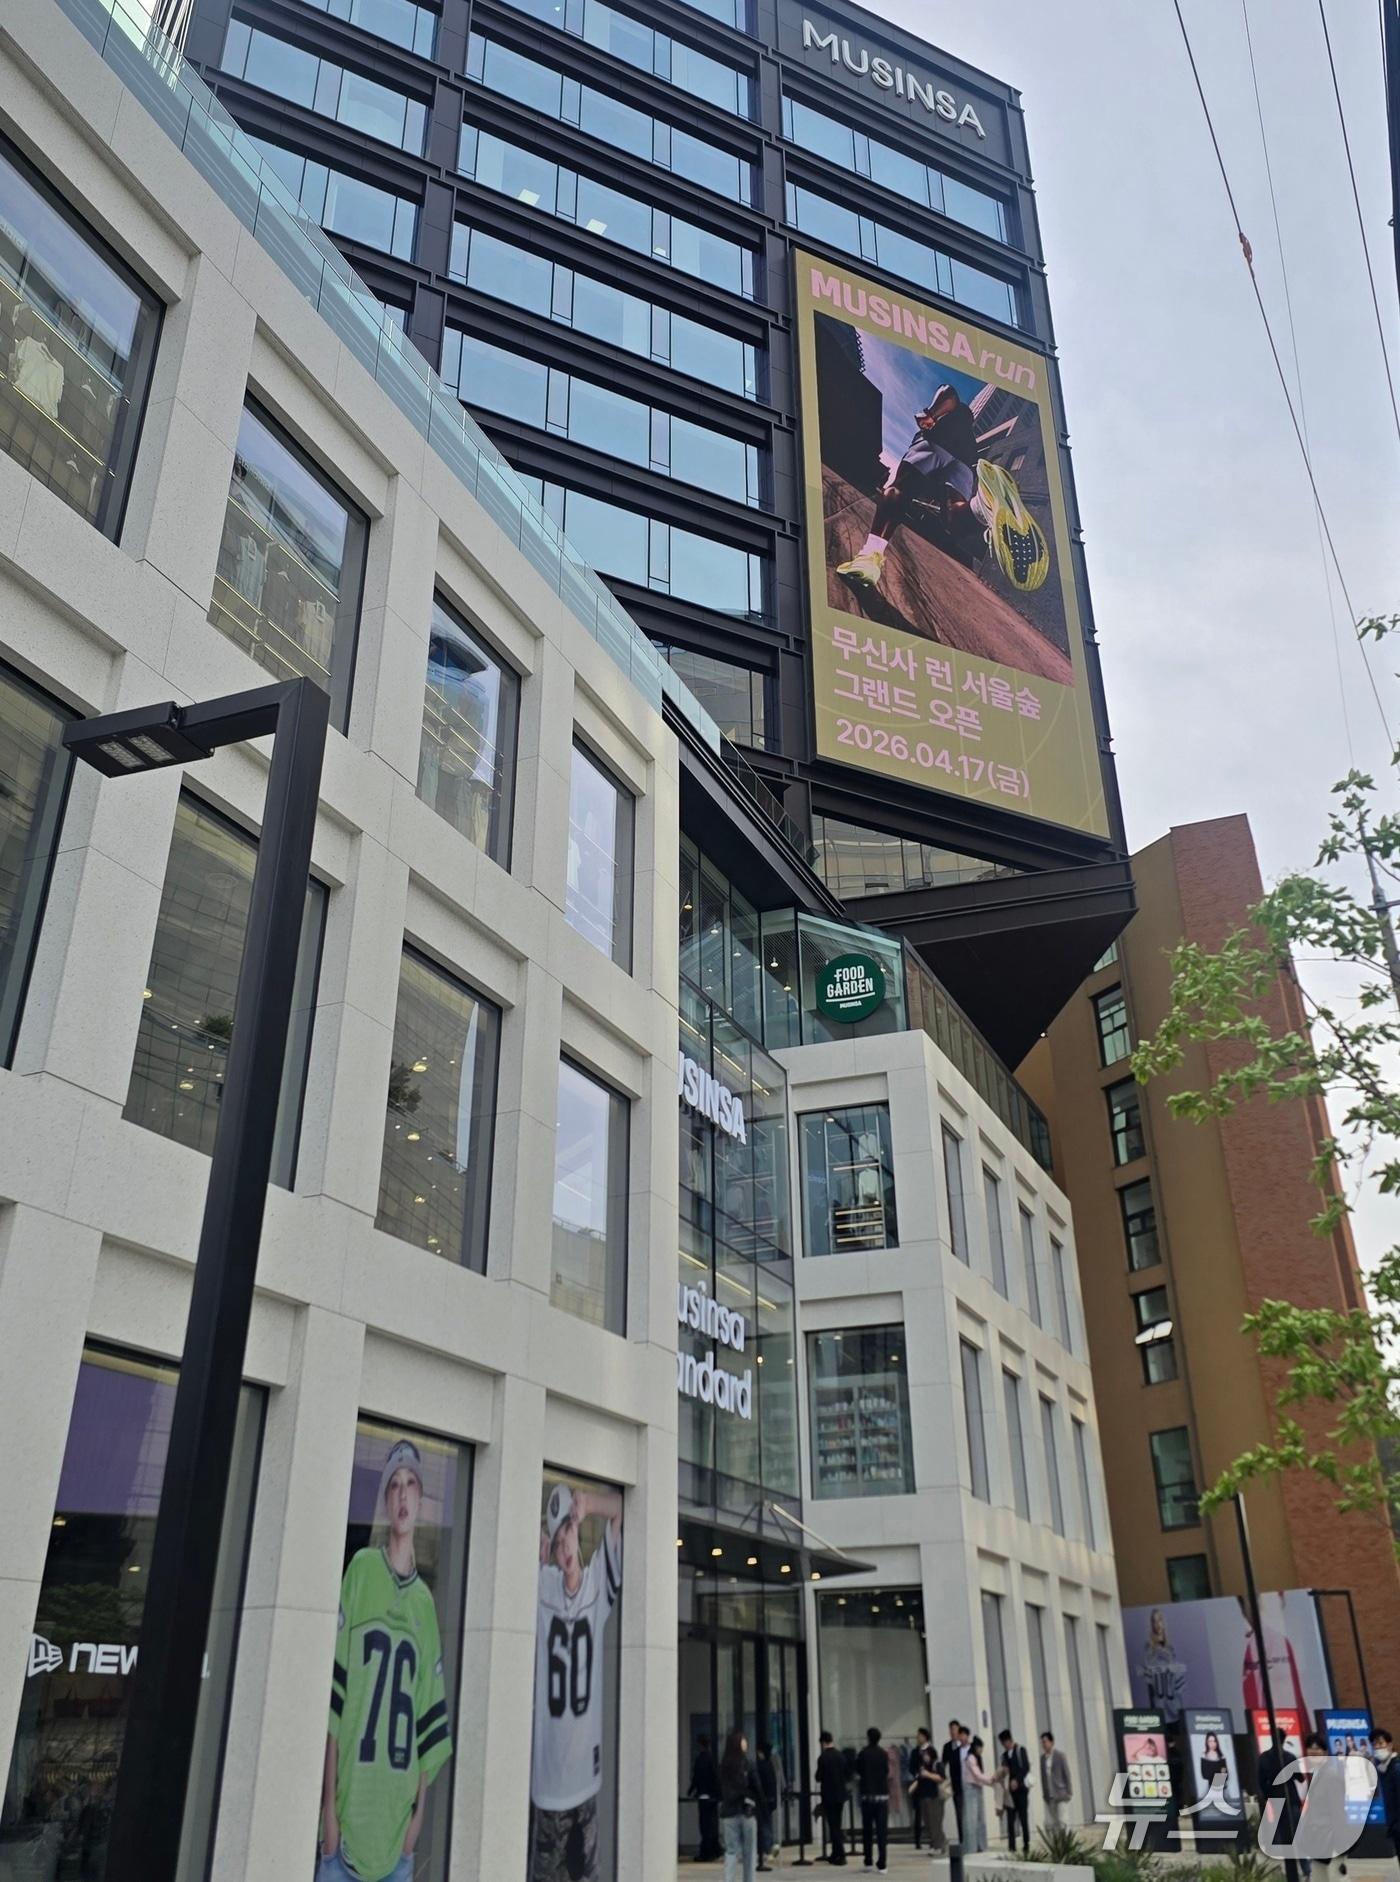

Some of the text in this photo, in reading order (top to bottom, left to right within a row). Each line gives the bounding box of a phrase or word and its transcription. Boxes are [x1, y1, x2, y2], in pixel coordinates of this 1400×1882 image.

[802, 18, 986, 139] MUSINSA
[810, 268, 1036, 391] MUSINSA run
[831, 626, 1042, 721] 무신사 런 서울숲
[833, 668, 983, 742] 그랜드 오픈
[835, 718, 1030, 799] 2026.04.17(금)
[826, 978, 874, 998] GARDEN
[834, 965, 866, 982] FOOD
[358, 1628, 417, 1772] 76
[547, 1615, 594, 1719] 60
